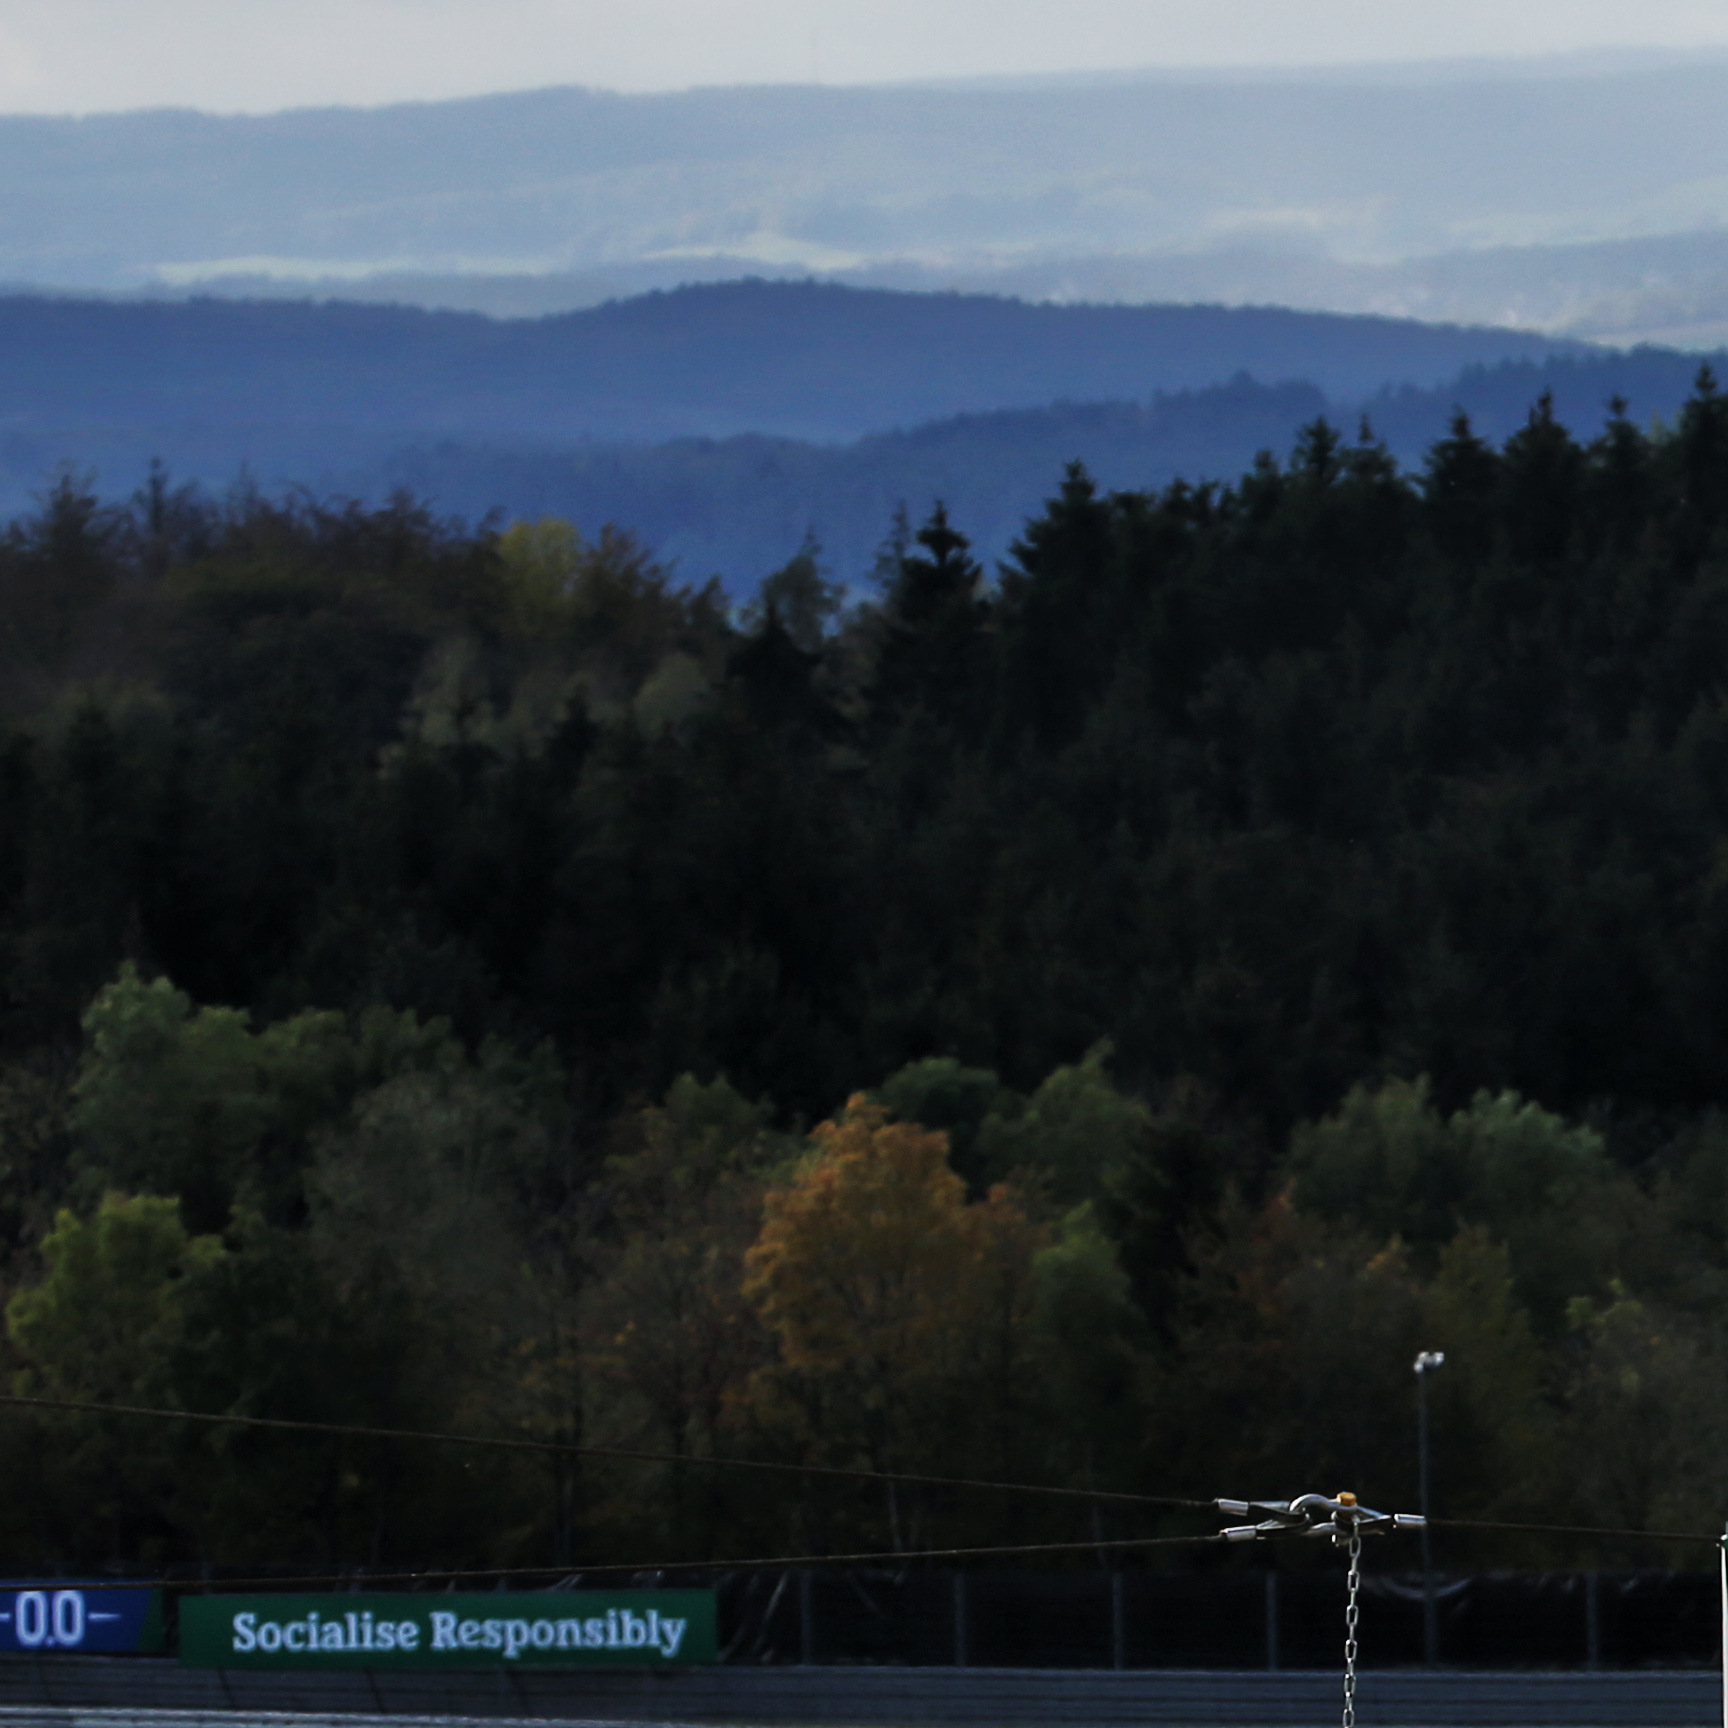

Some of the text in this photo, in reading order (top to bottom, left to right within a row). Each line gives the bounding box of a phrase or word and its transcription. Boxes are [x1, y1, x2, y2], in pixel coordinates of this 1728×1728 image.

[16, 1591, 85, 1646] 0.0
[232, 1608, 687, 1659] Socialise Responsibly
